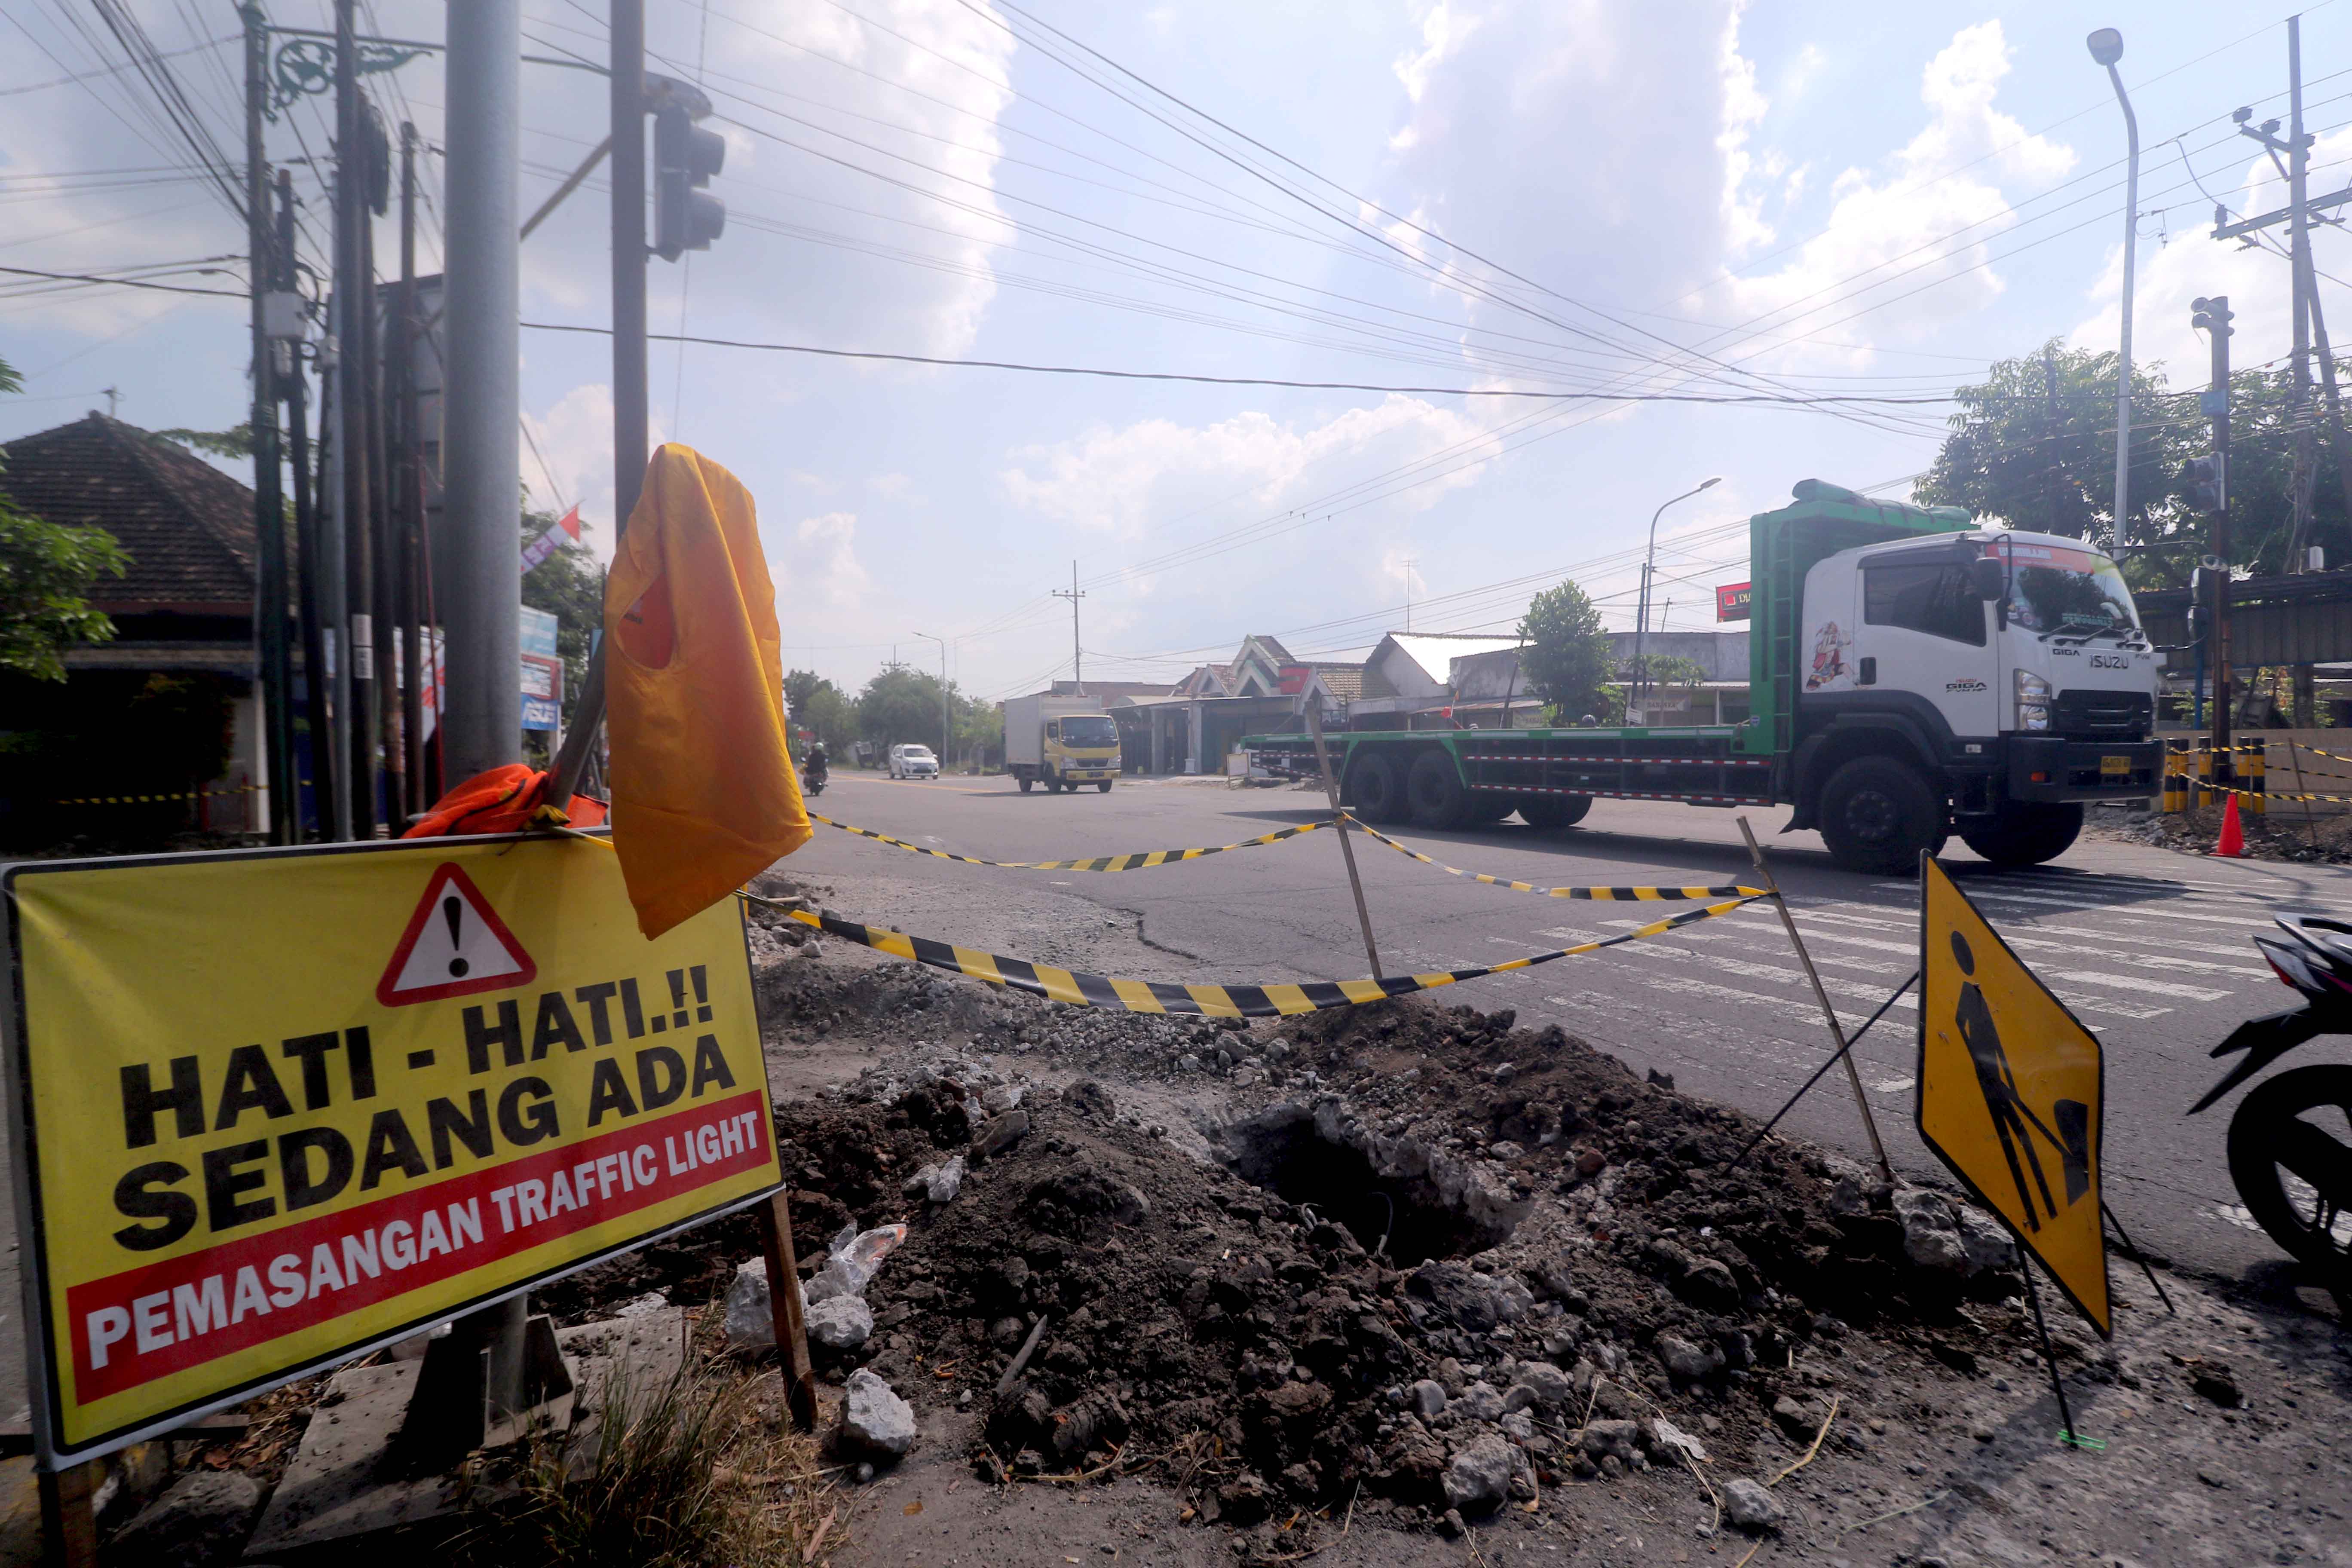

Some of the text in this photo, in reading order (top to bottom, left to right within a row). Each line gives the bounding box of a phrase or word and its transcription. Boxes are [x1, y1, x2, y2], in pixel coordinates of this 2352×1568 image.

[2052, 648, 2080, 656] GIGA
[2089, 654, 2128, 669] ISUZU
[113, 1035, 735, 1251] SEDANG ADA
[120, 1026, 376, 1149] HATI
[462, 965, 712, 1074] HATI.!!
[87, 1111, 756, 1369] PEMASANGAN TRAFFIC LIGHT
